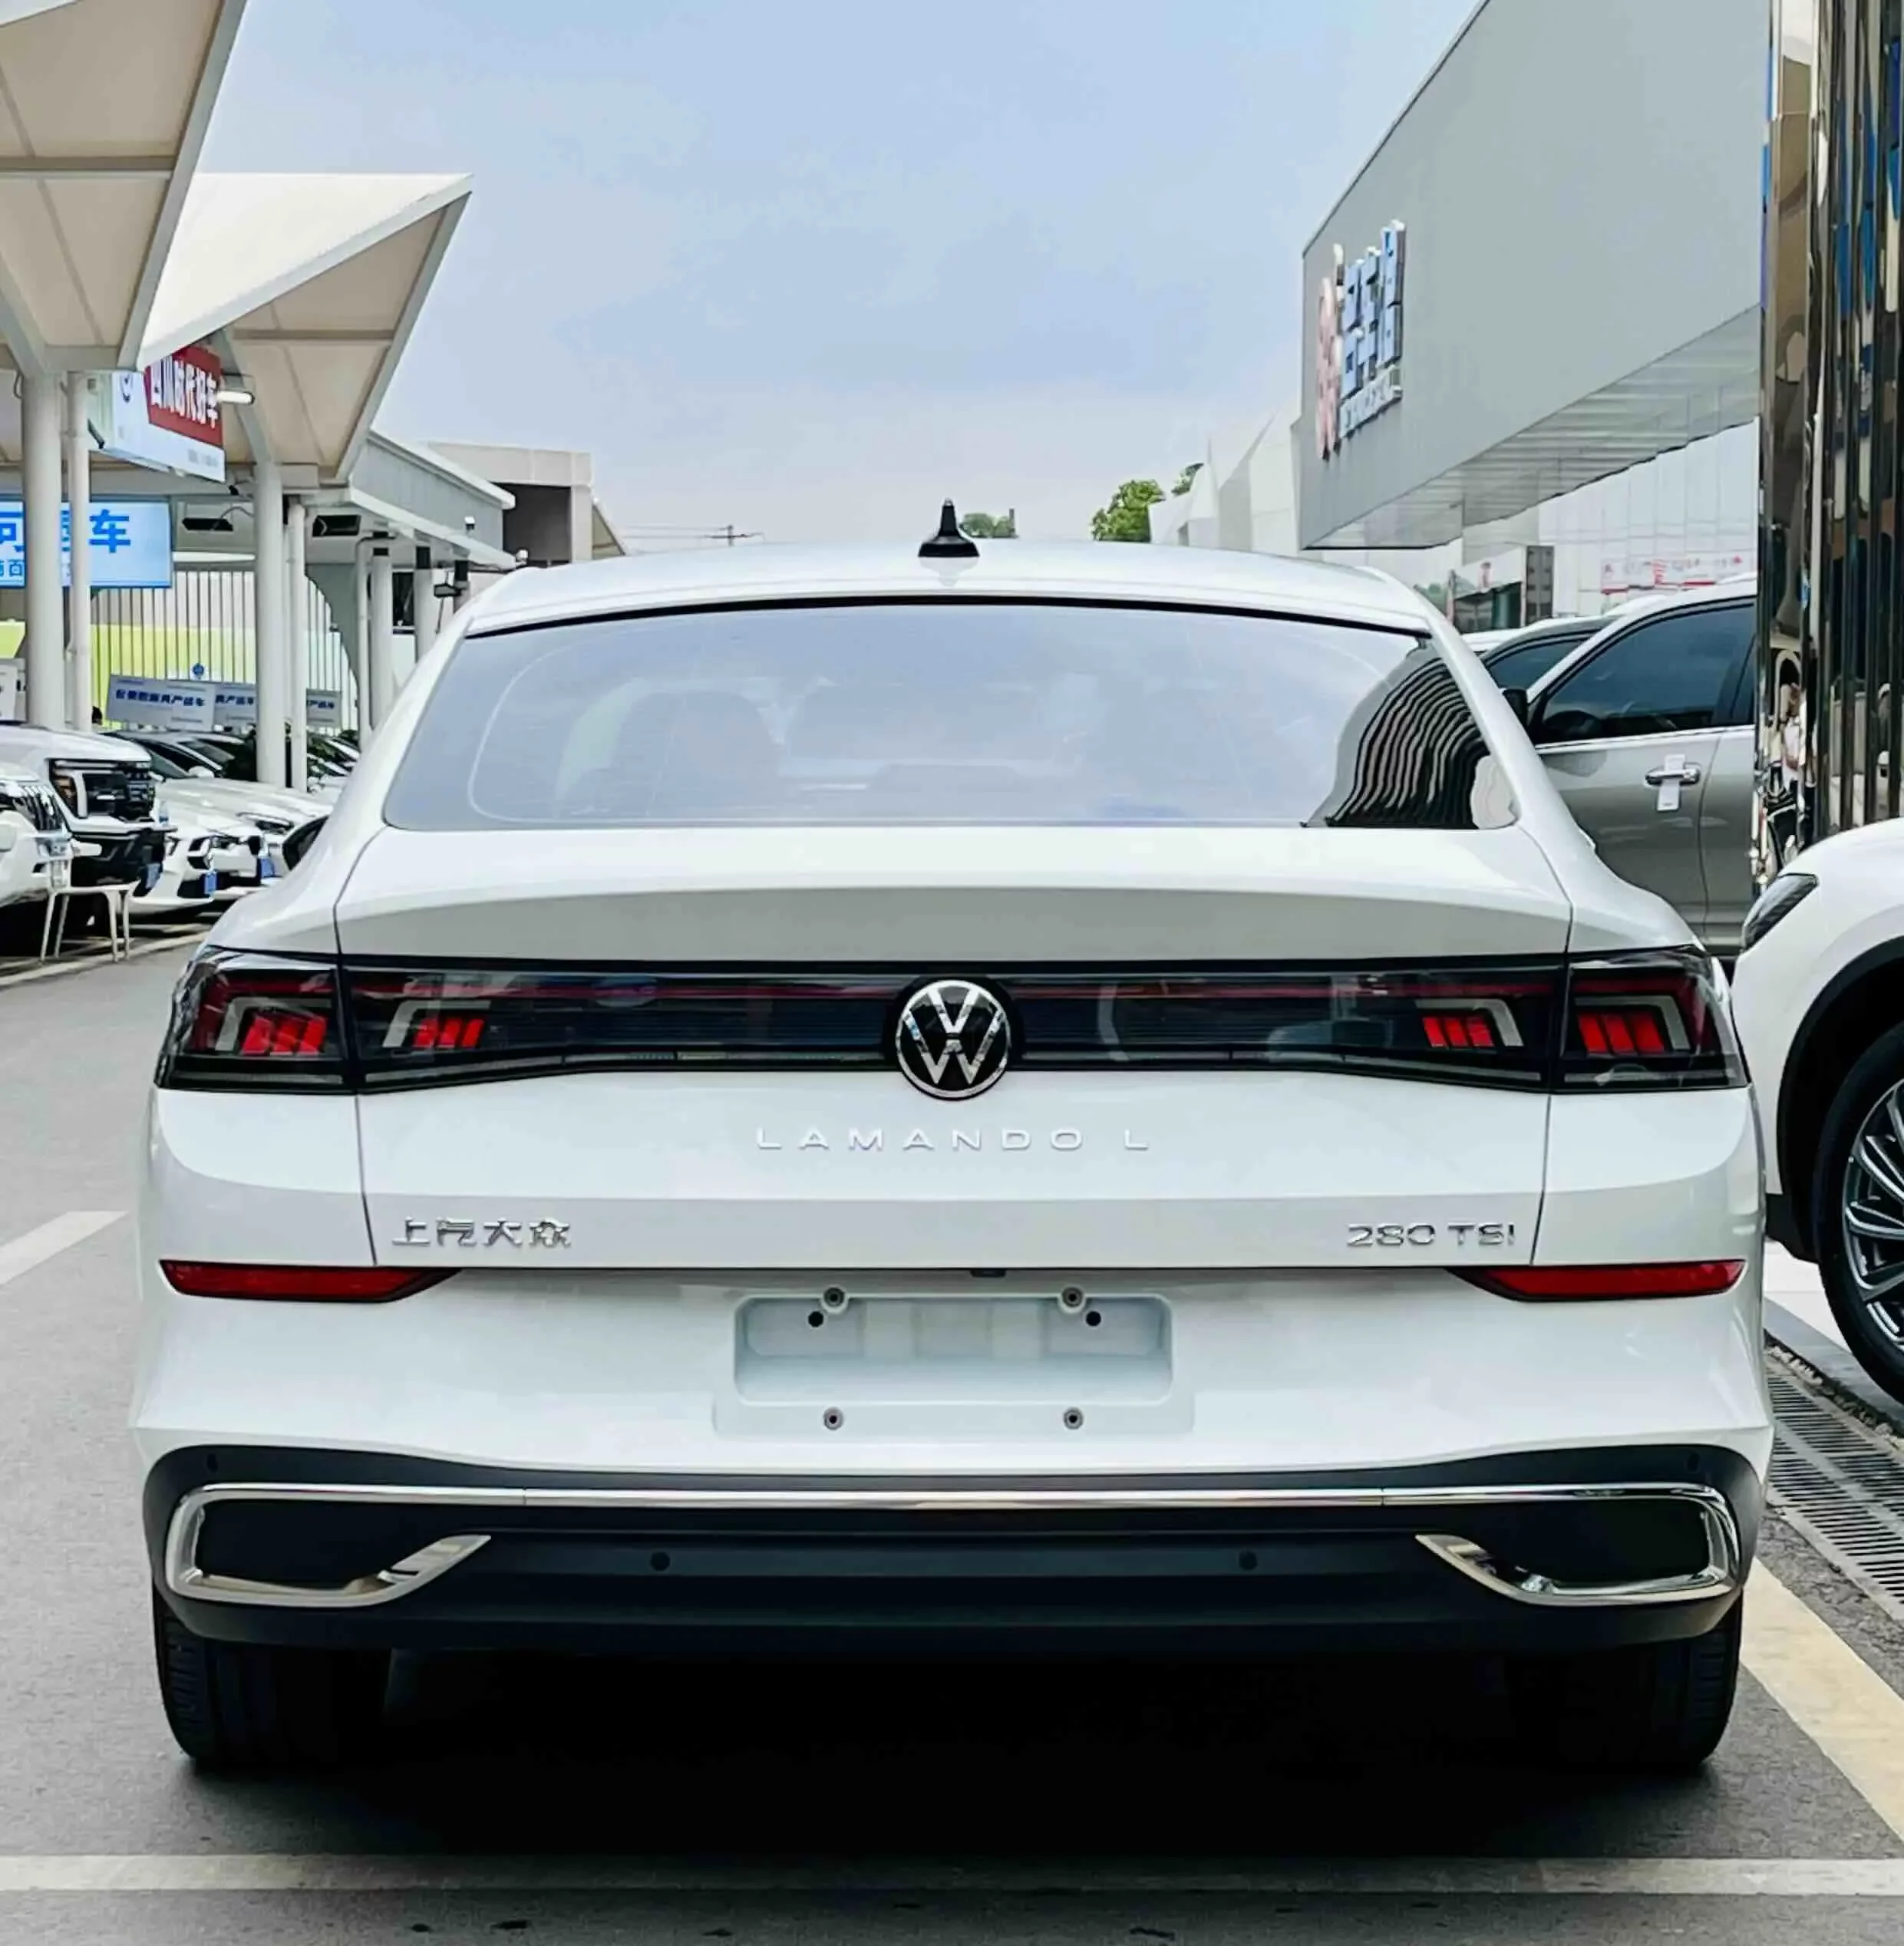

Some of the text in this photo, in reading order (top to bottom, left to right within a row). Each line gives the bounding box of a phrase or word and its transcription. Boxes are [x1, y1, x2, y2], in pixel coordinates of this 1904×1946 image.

[756, 1127, 1150, 1150] LAMANDO L
[391, 1215, 571, 1248] 上汽大众
[1347, 1222, 1516, 1246] 280 TSI
